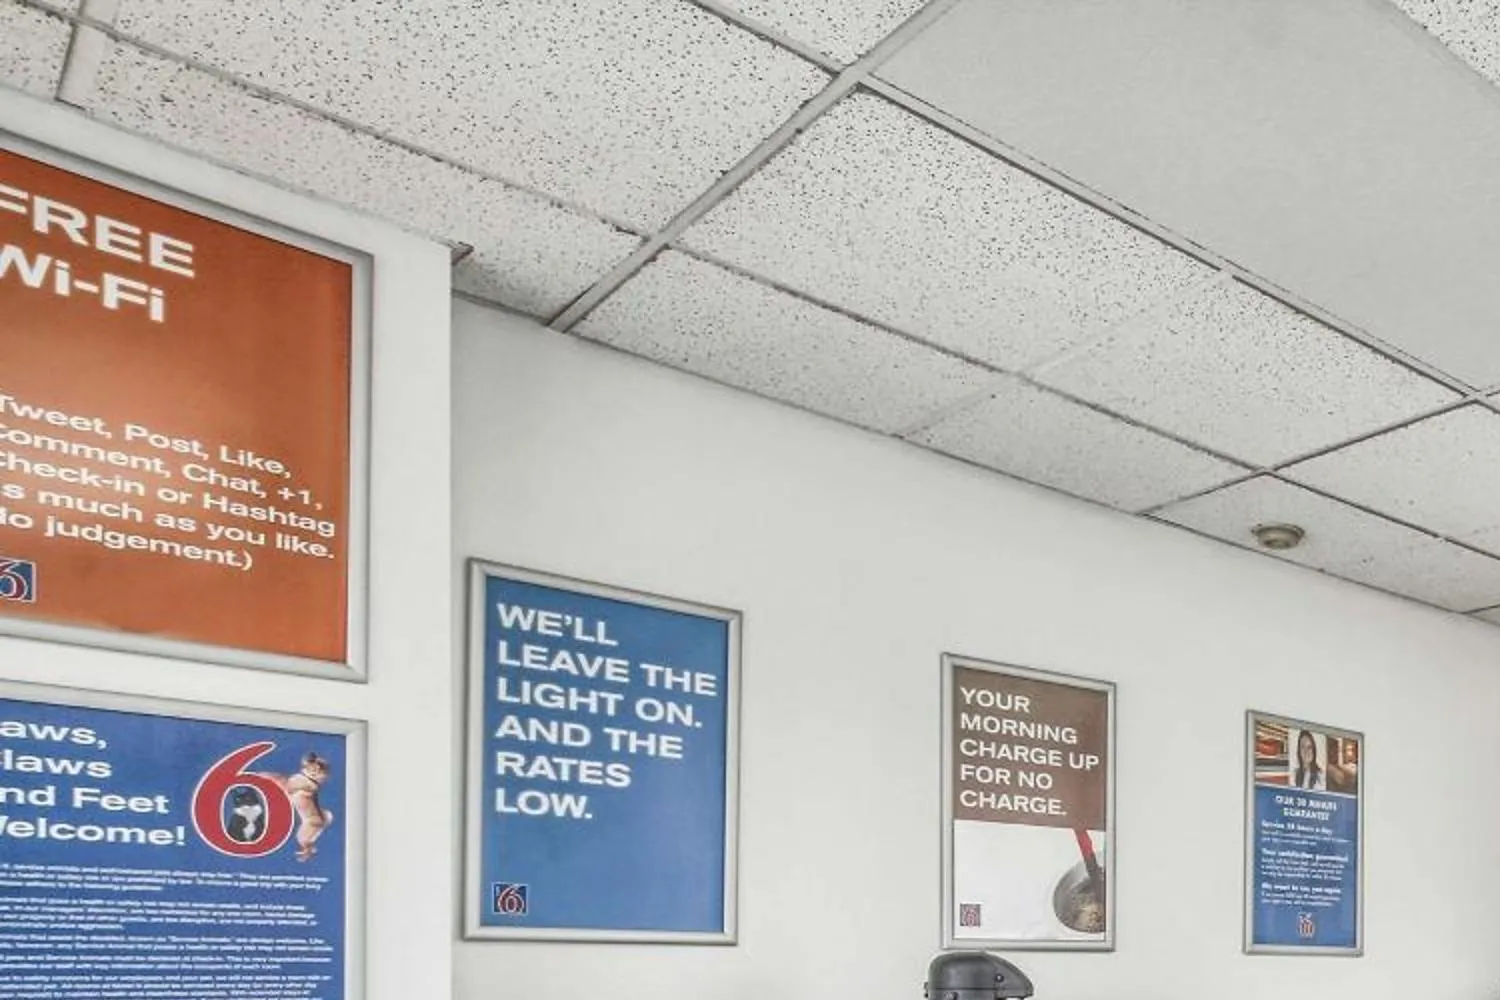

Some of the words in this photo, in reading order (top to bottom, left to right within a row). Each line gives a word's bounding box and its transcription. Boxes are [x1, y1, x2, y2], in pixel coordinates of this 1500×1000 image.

[0, 183, 195, 279] FREE
[0, 243, 165, 323] Wi-Fi
[0, 394, 112, 439] Tweet,
[124, 423, 209, 460] Post,
[219, 445, 292, 478] Like,
[182, 463, 266, 498] Chat,
[277, 487, 323, 510] +1,
[38, 490, 144, 522] much
[155, 512, 197, 532] as
[206, 523, 265, 546] you
[275, 533, 335, 558] like.
[156, 488, 193, 505] or
[202, 492, 336, 537] Hashtag
[44, 515, 253, 571] judgement.)
[496, 602, 618, 646] WE'LL
[497, 640, 631, 683] LEAVE
[640, 663, 718, 697] THE
[497, 677, 624, 717] LIGHT
[635, 698, 703, 728] ON.
[960, 686, 1031, 713] YOUR
[0, 721, 107, 749] aws,
[495, 714, 592, 748] AND
[603, 727, 684, 759] THE
[960, 712, 1078, 745] MORNING
[0, 749, 113, 779] laws
[495, 751, 632, 788] RATES
[959, 738, 1063, 767] CHARGE
[1068, 752, 1100, 771] UP
[959, 763, 1011, 786] FOR
[1018, 770, 1053, 790] NO
[0, 786, 56, 807] nd
[72, 787, 171, 814] Feet
[191, 741, 295, 858] 6
[495, 787, 594, 819] LOW.
[959, 789, 1068, 816] CHARGE.
[0, 815, 186, 845] elcome!
